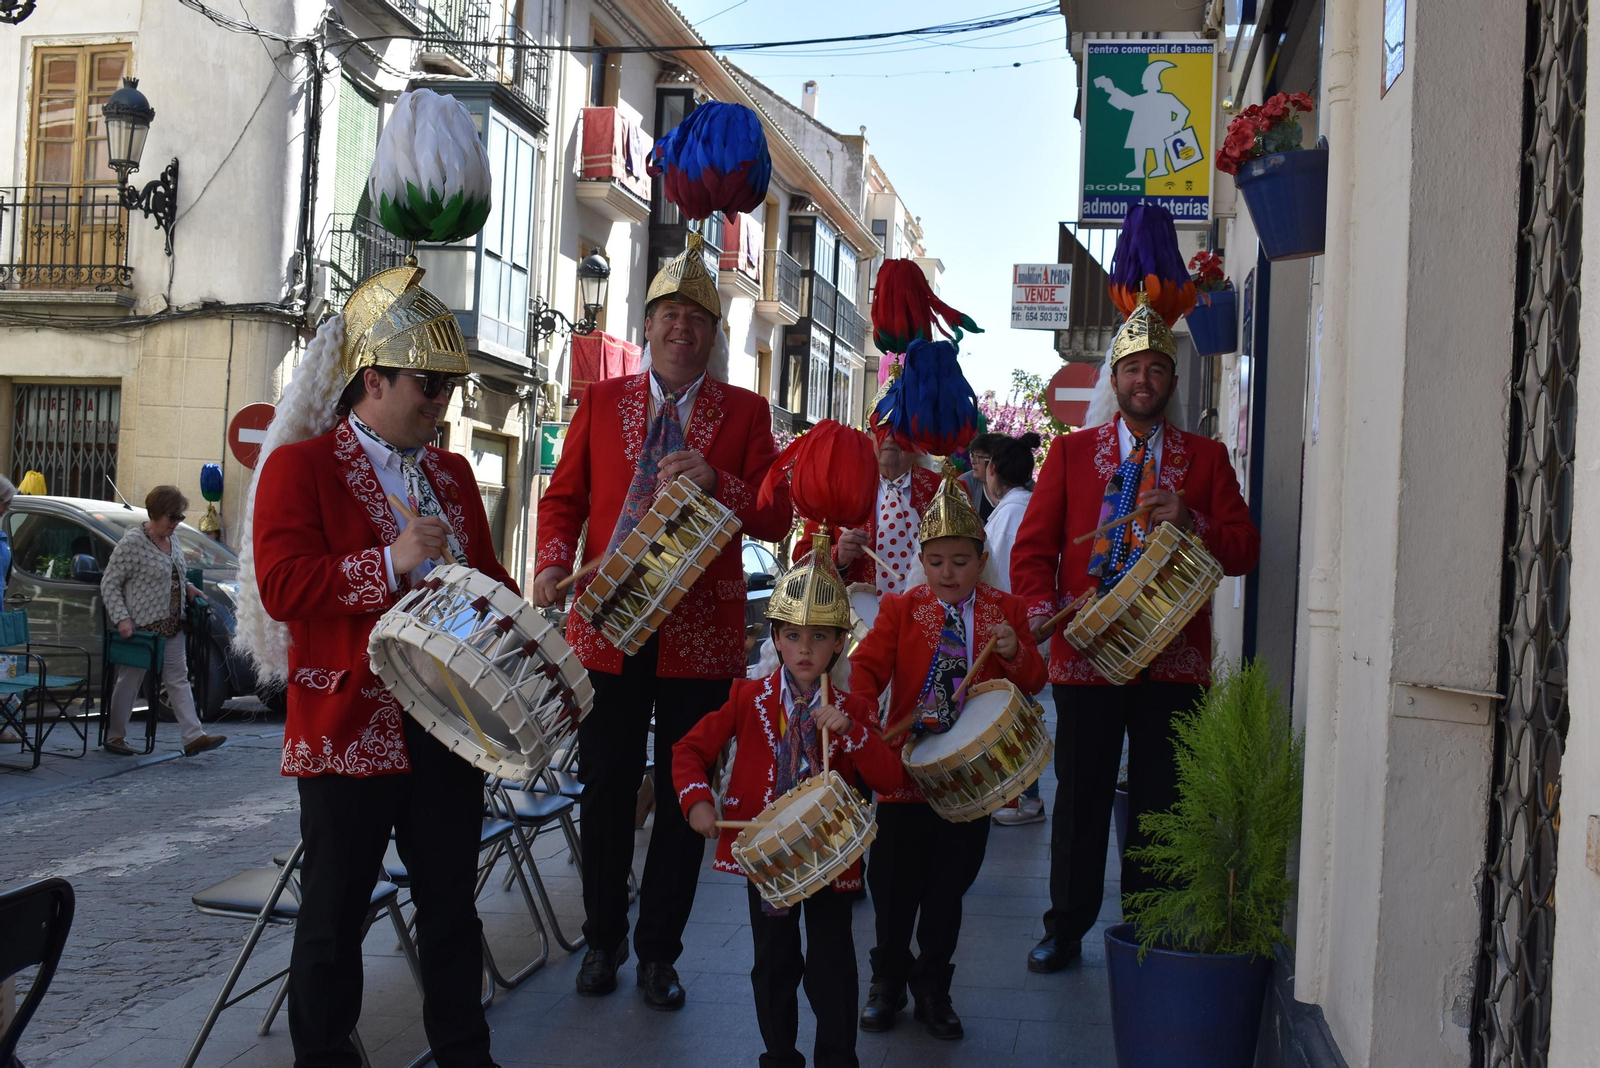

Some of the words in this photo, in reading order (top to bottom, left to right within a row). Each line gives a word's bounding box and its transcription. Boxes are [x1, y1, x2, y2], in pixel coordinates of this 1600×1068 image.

[1088, 45, 1119, 54] centro
[1121, 44, 1168, 54] comercial
[1170, 44, 1182, 54] de
[1185, 44, 1213, 54] baena
[1084, 182, 1141, 191] acoba
[1083, 198, 1128, 215] admon
[1024, 288, 1056, 302] VENDE
[1011, 312, 1022, 321] Tlf:
[1025, 312, 1038, 321] 654
[1040, 312, 1053, 321] 503
[1054, 312, 1068, 322] 379
[1174, 455, 1182, 464] 6
